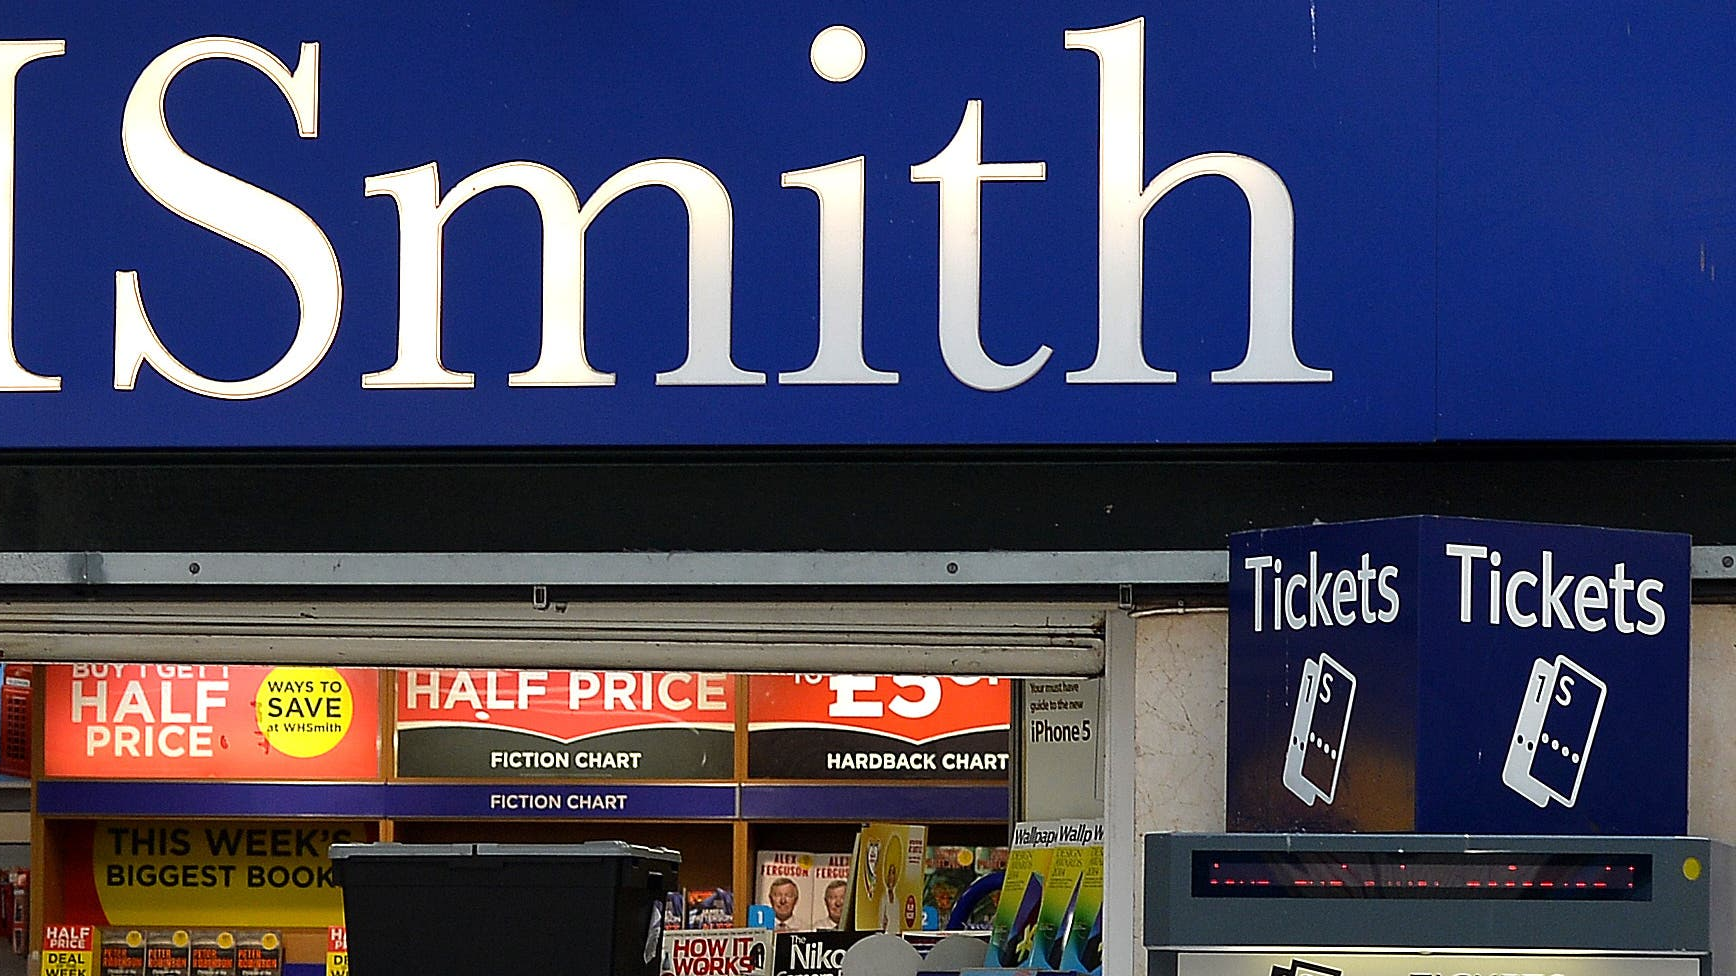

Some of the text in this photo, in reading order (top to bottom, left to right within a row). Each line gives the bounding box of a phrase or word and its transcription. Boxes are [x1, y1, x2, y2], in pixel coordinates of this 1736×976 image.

[1245, 551, 1400, 632] Tickets
[1446, 544, 1666, 636] Tickets
[267, 680, 342, 693] WAYS TO
[406, 670, 728, 711] HALF PRICE
[71, 680, 229, 724] HALF
[267, 697, 342, 718] SAVE
[284, 722, 342, 733] WHSmith
[1031, 719, 1091, 743] iPhone 5
[86, 725, 213, 758] PRICE
[490, 751, 642, 769] FICTION CHART
[827, 753, 1010, 770] HARDBACK CHART
[490, 793, 628, 810] FICTION CHART
[107, 827, 192, 857] THIS
[1015, 826, 1058, 847] Wallpap
[1058, 825, 1093, 845] Wallp
[774, 854, 797, 865] ALEX
[106, 864, 334, 889] BIGGEST BOOK
[761, 865, 810, 877] FERGUSON
[816, 867, 850, 880] FERGUS
[757, 911, 764, 924] 1
[46, 927, 90, 939] HALF
[790, 935, 807, 944] The
[50, 938, 86, 949] PRICE
[673, 937, 754, 957] HOW IT
[48, 952, 85, 965] DEAL
[790, 941, 847, 970] Niko
[673, 956, 756, 976] WORKS
